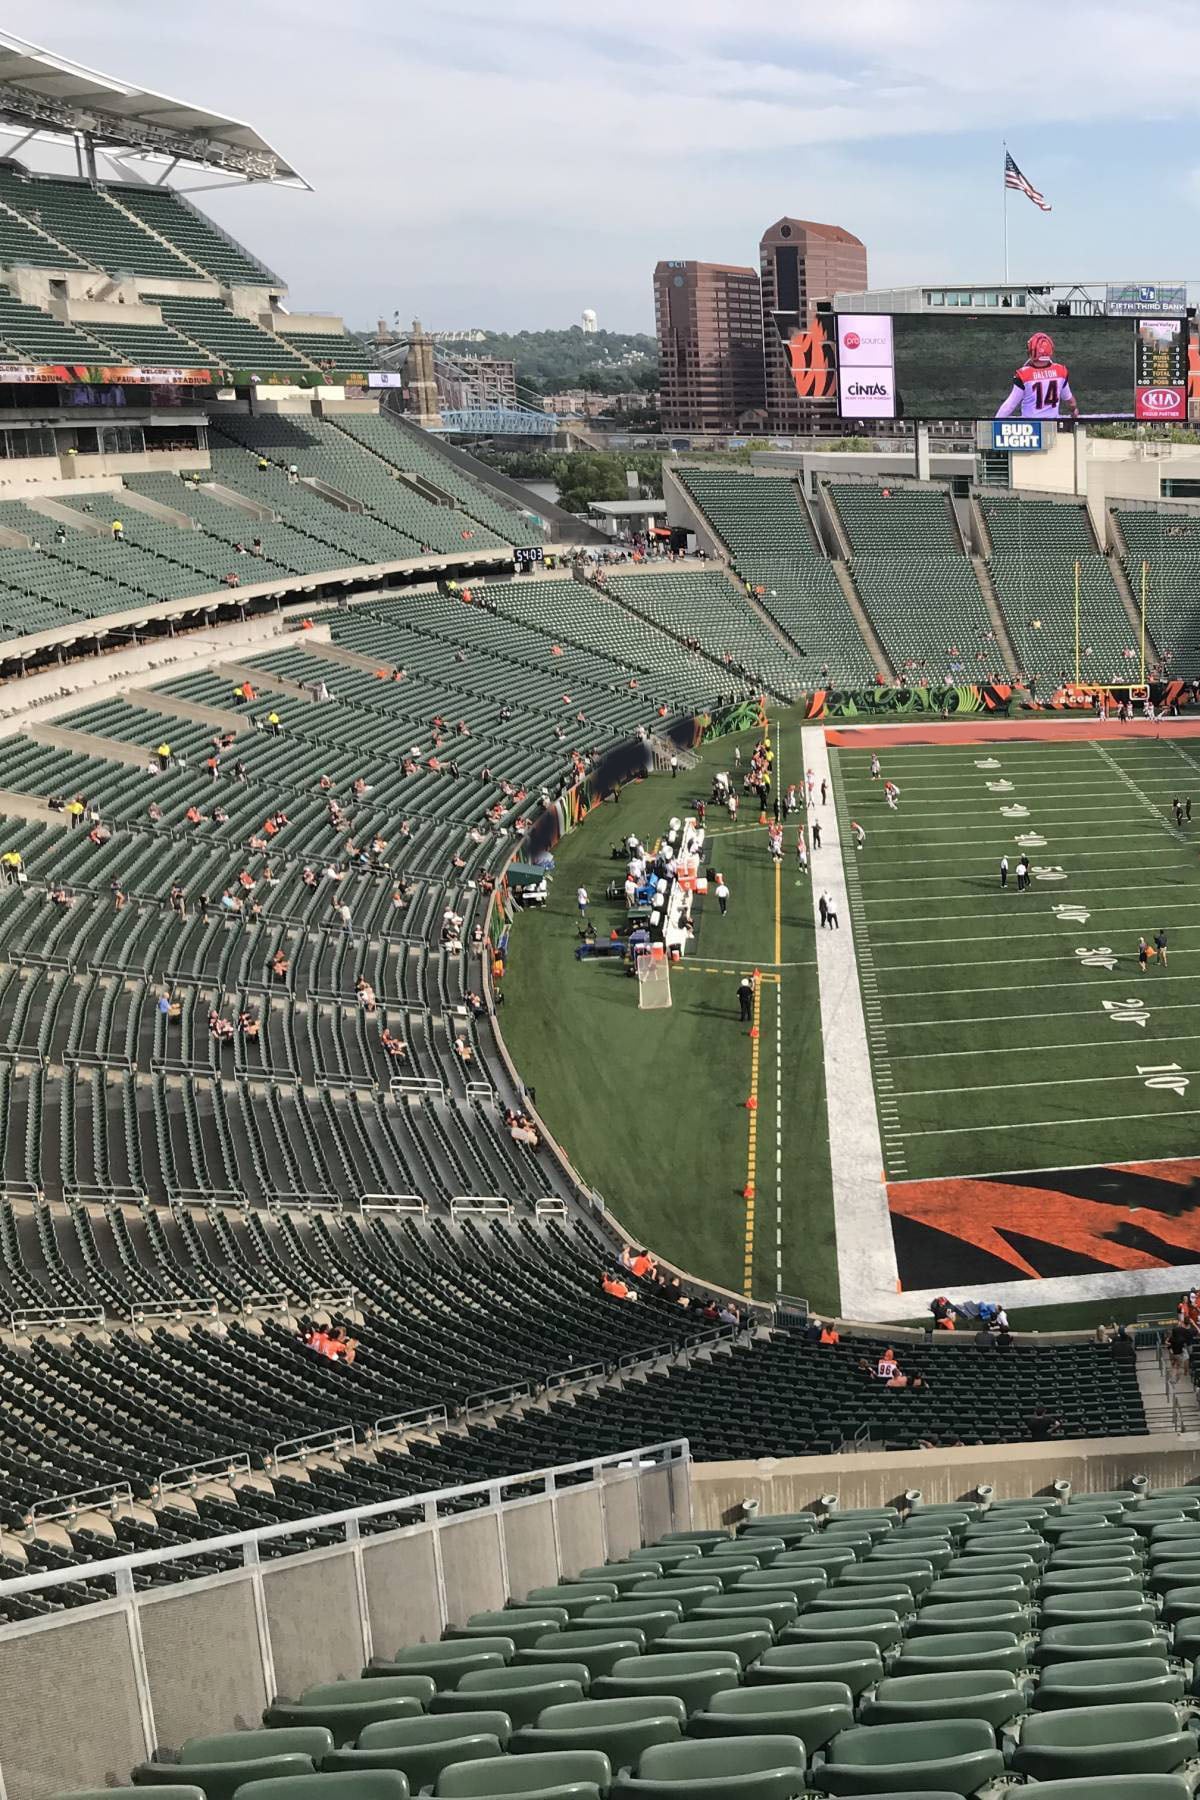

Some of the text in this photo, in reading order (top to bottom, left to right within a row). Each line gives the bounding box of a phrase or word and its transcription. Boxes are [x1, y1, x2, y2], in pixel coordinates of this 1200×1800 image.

[1033, 369, 1057, 380] DALTON
[1032, 380, 1059, 410] 14
[1148, 393, 1174, 405] KIA
[1001, 423, 1034, 436] BUD
[995, 435, 1040, 448] LIGHT
[1075, 947, 1118, 966] 30
[1101, 998, 1151, 1021] 20
[1135, 1062, 1190, 1089] 10
[880, 1364, 891, 1375] 96
